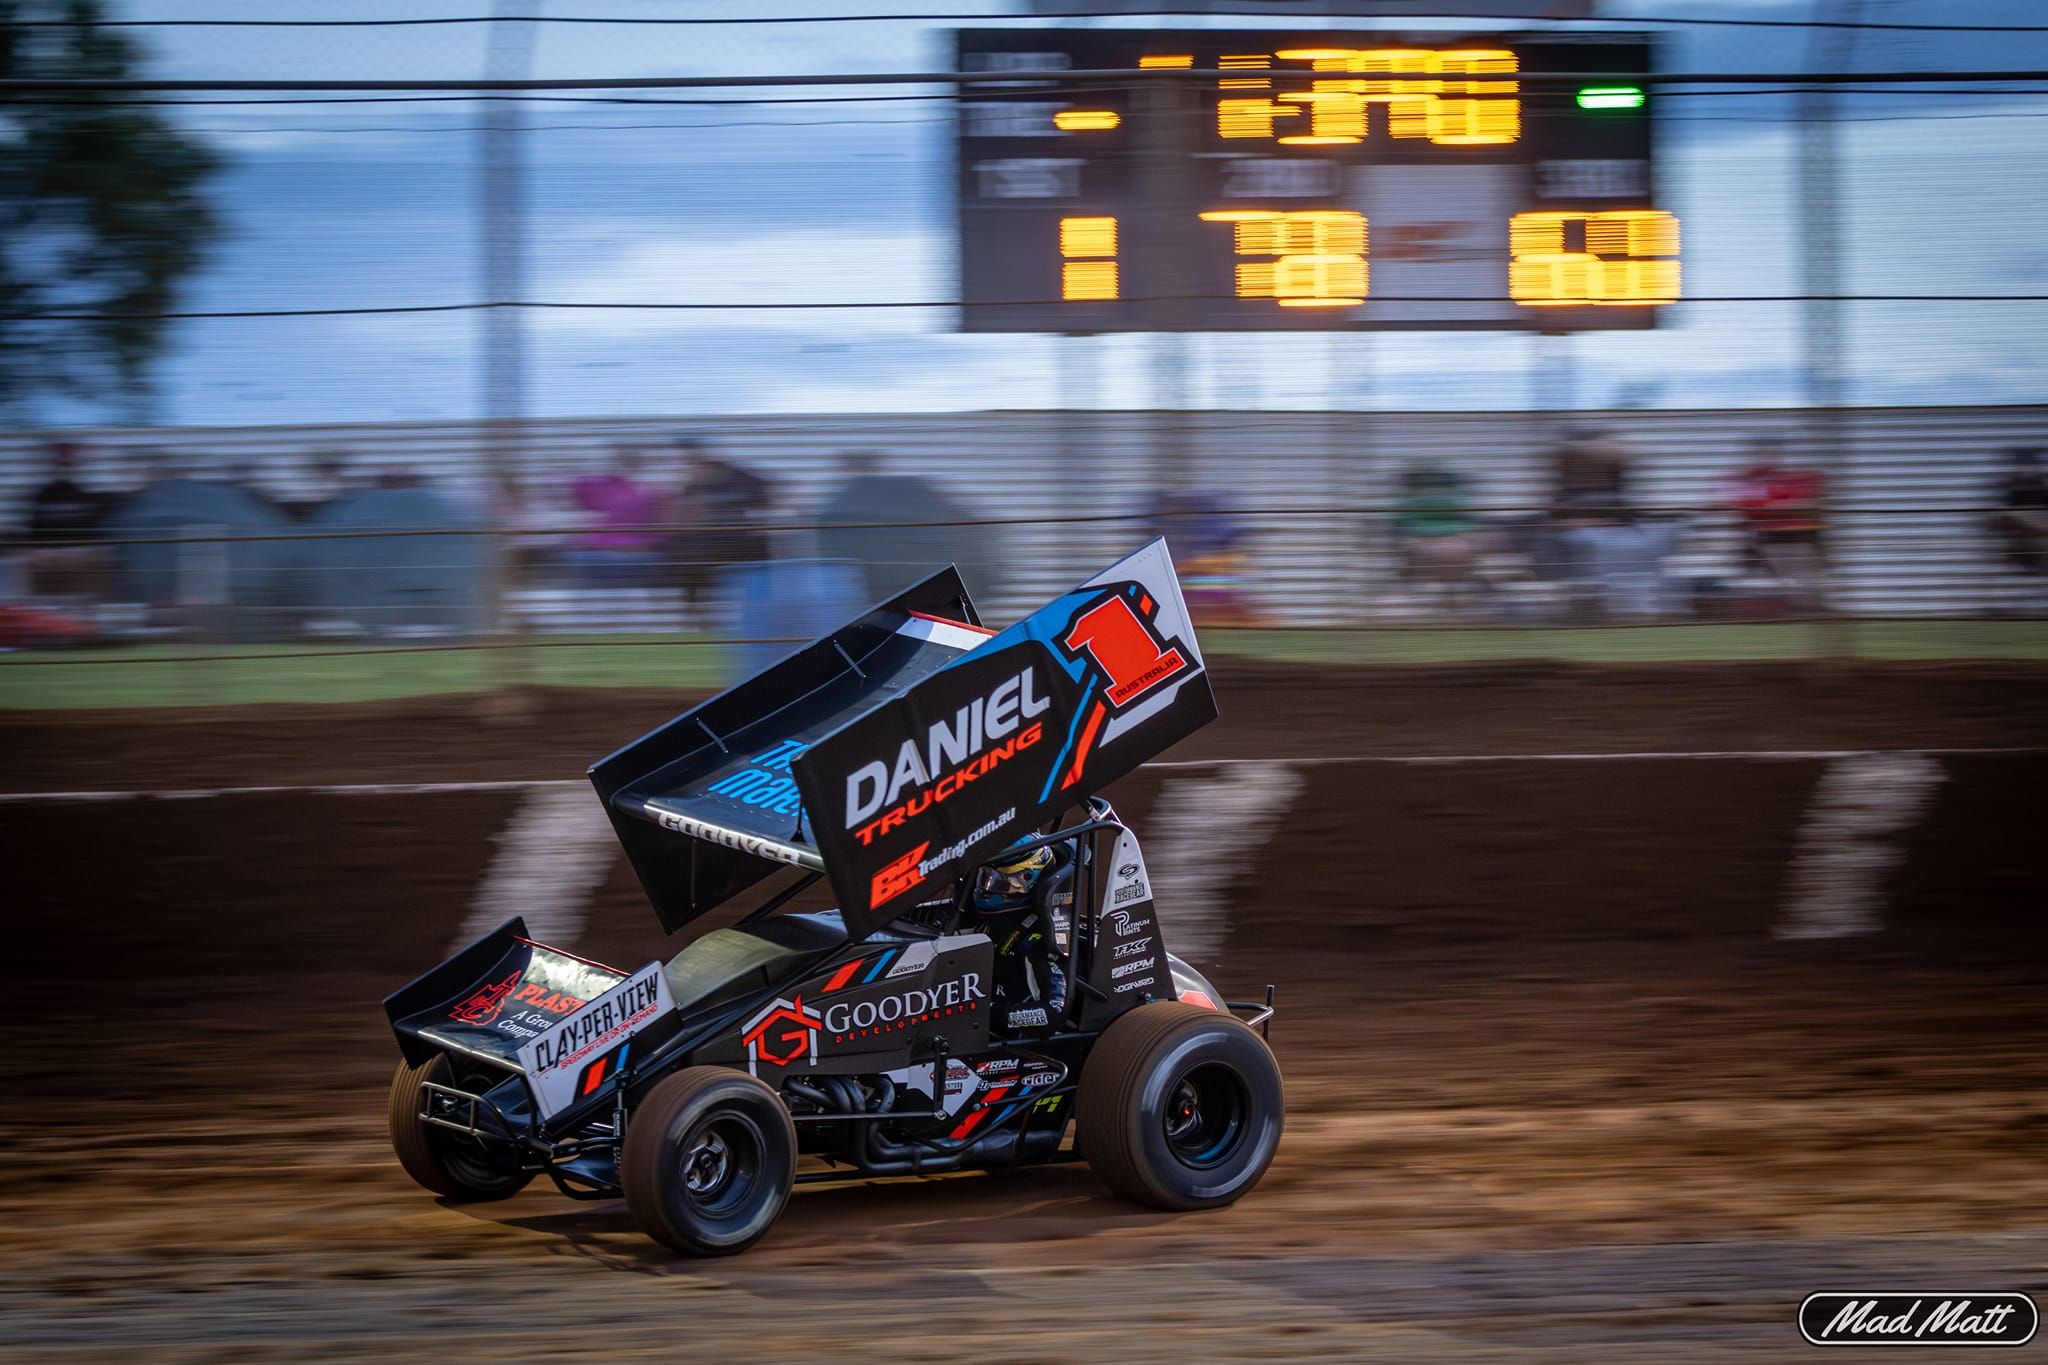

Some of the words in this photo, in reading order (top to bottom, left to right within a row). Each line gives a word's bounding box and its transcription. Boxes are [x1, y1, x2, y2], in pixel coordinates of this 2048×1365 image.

[1064, 594, 1188, 708] 1
[1115, 657, 1178, 698] AUSTRALIA
[846, 666, 1050, 830] DANIEL
[855, 722, 1042, 846] TRUCKING
[918, 807, 1016, 877] Trading.com.au
[1124, 956, 1155, 973] RPM
[511, 1010, 528, 1020] A
[535, 971, 658, 1072] CLAY-PER-VIEW
[825, 973, 986, 1033] GOODYER
[835, 1002, 977, 1044] DEVELOPMENTS
[989, 1059, 1020, 1070] RPM
[1023, 1073, 1060, 1086] rider
